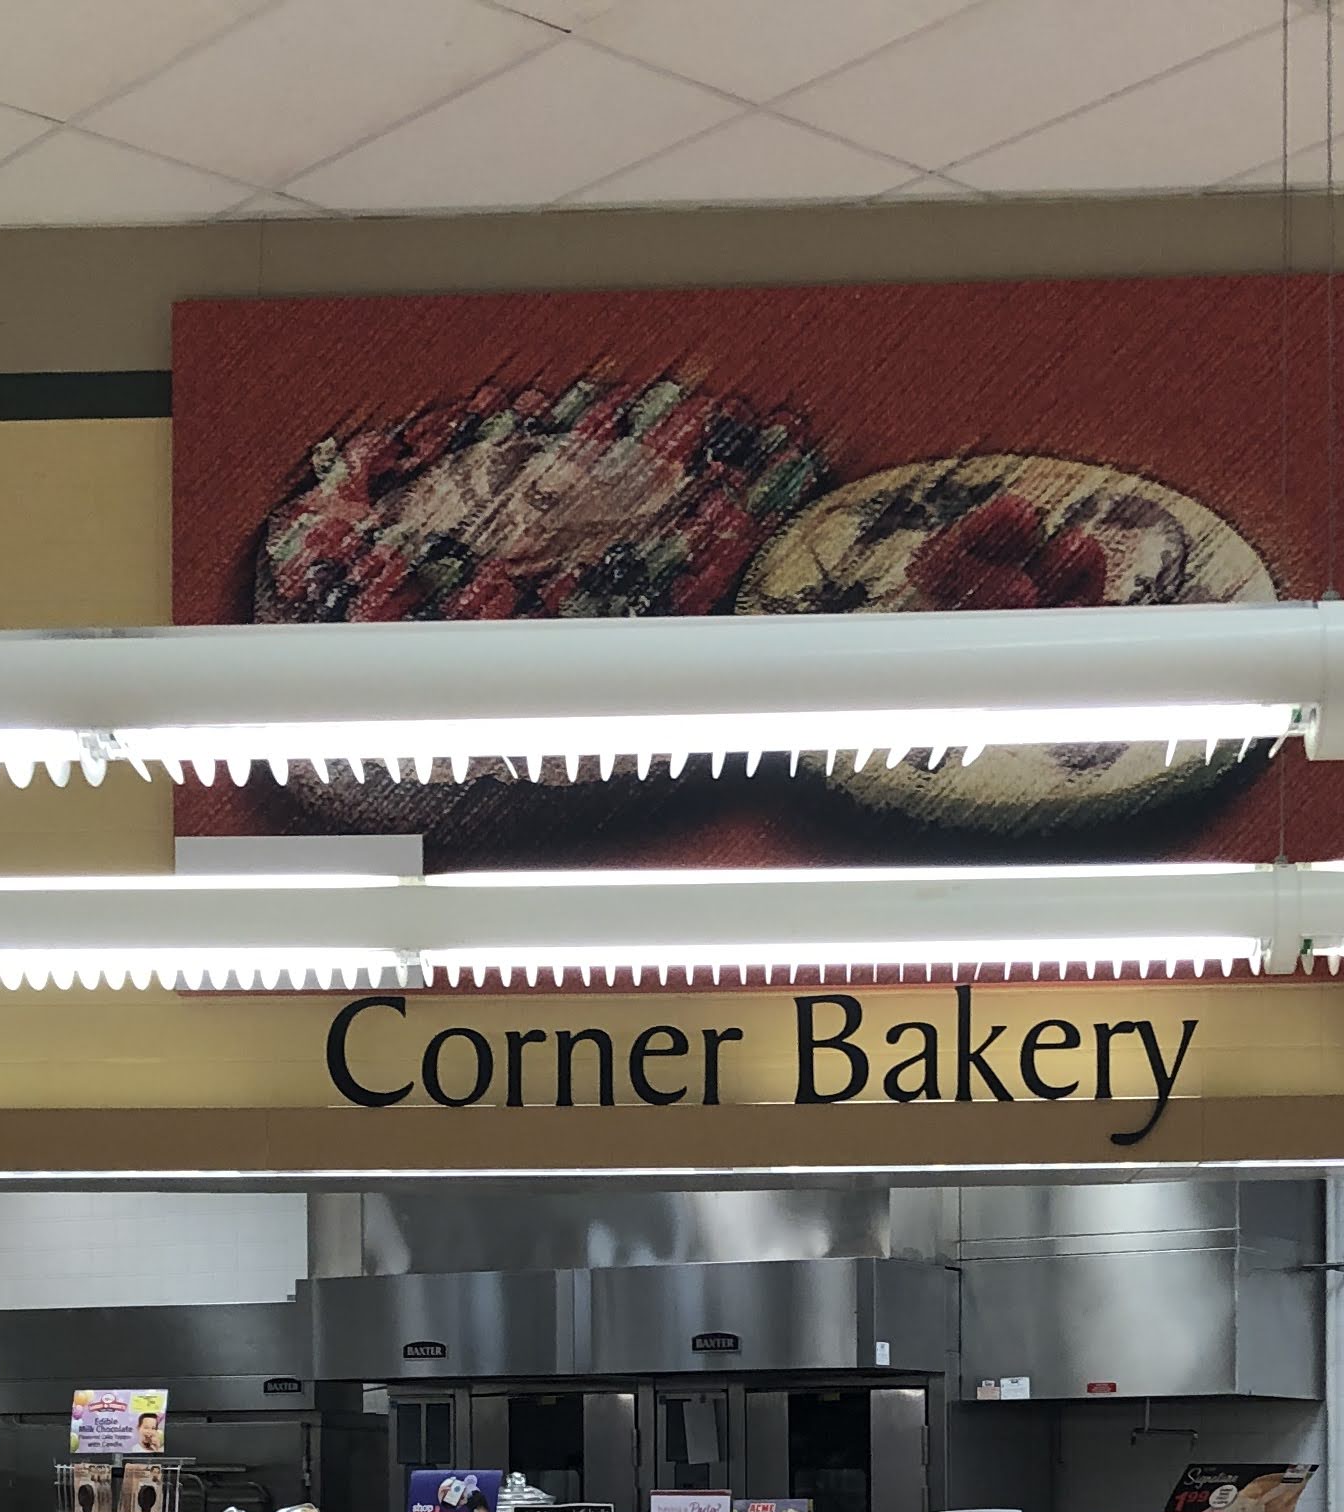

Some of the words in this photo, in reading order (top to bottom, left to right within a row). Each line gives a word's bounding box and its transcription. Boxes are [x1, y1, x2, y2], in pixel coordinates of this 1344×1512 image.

[325, 996, 743, 1108] Corner
[792, 985, 1199, 1146] Bakery
[696, 1339, 735, 1348] BAXTER
[407, 1346, 442, 1356] BAXTER
[267, 1382, 298, 1391] BAXTER
[95, 1418, 118, 1426] Edible
[412, 1503, 433, 1512] shop
[749, 1504, 775, 1512] ACME
